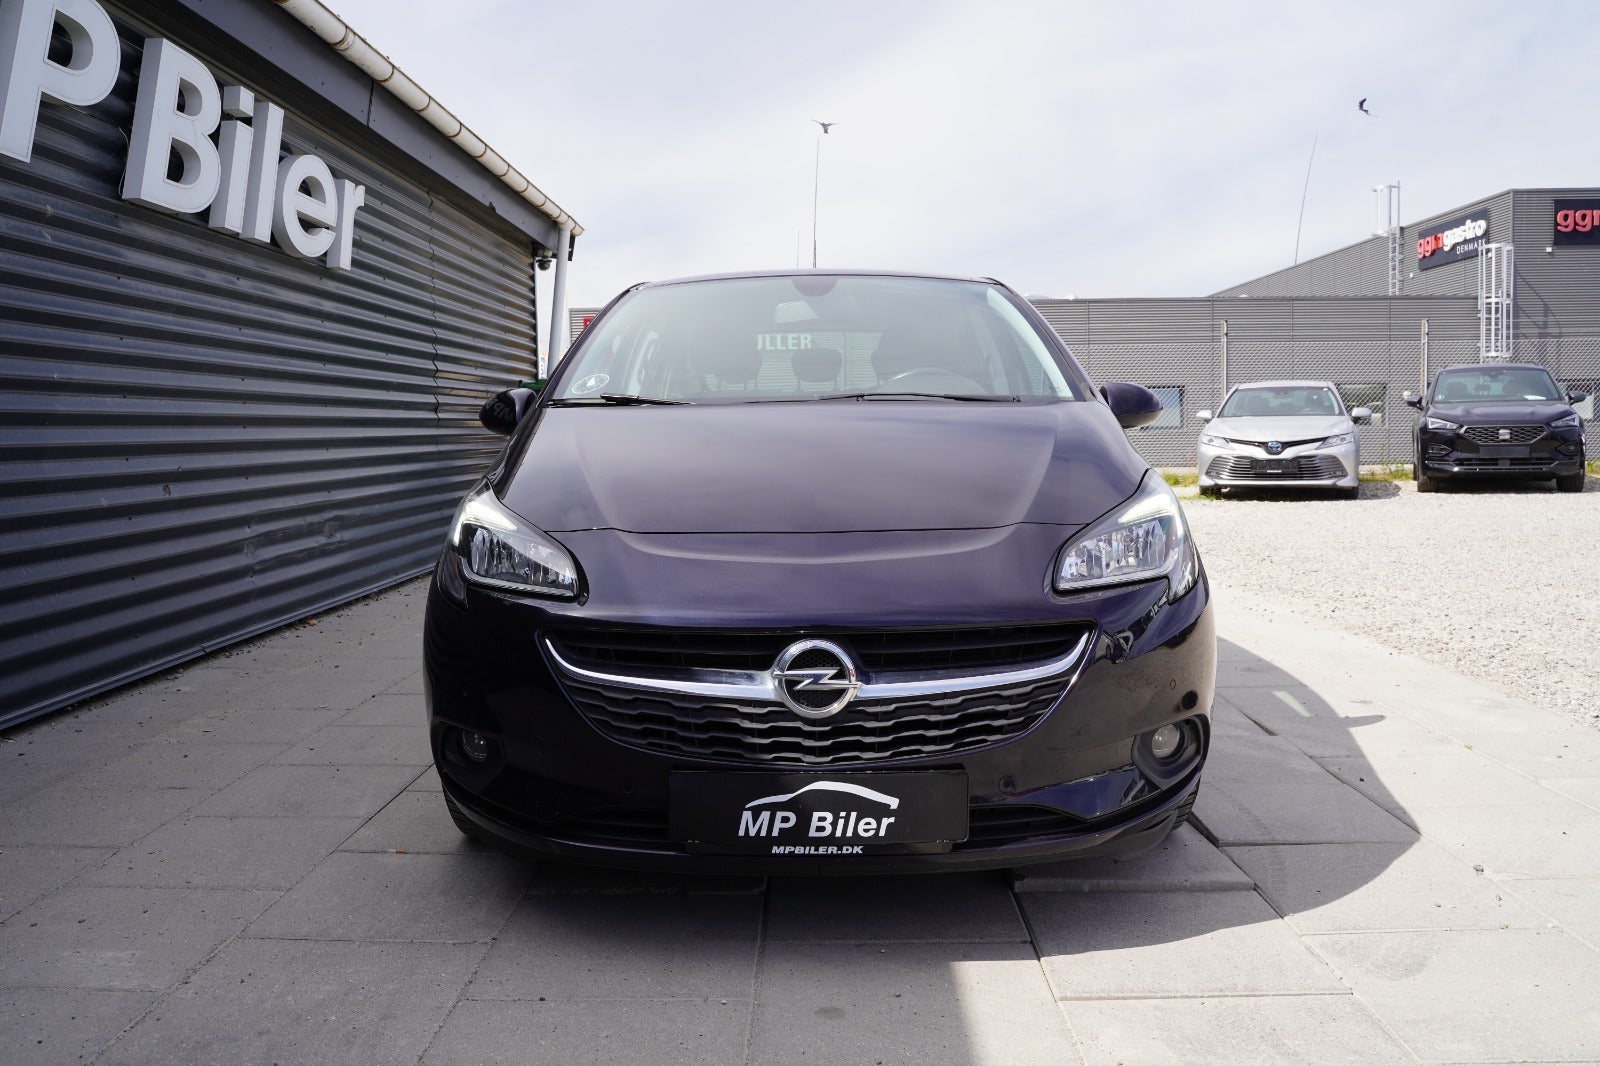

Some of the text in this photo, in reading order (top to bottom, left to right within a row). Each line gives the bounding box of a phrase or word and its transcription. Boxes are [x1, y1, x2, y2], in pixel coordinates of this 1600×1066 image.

[121, 38, 365, 271] Biler
[738, 810, 895, 838] MP Biler
[771, 845, 864, 854] MPBILER.DK
